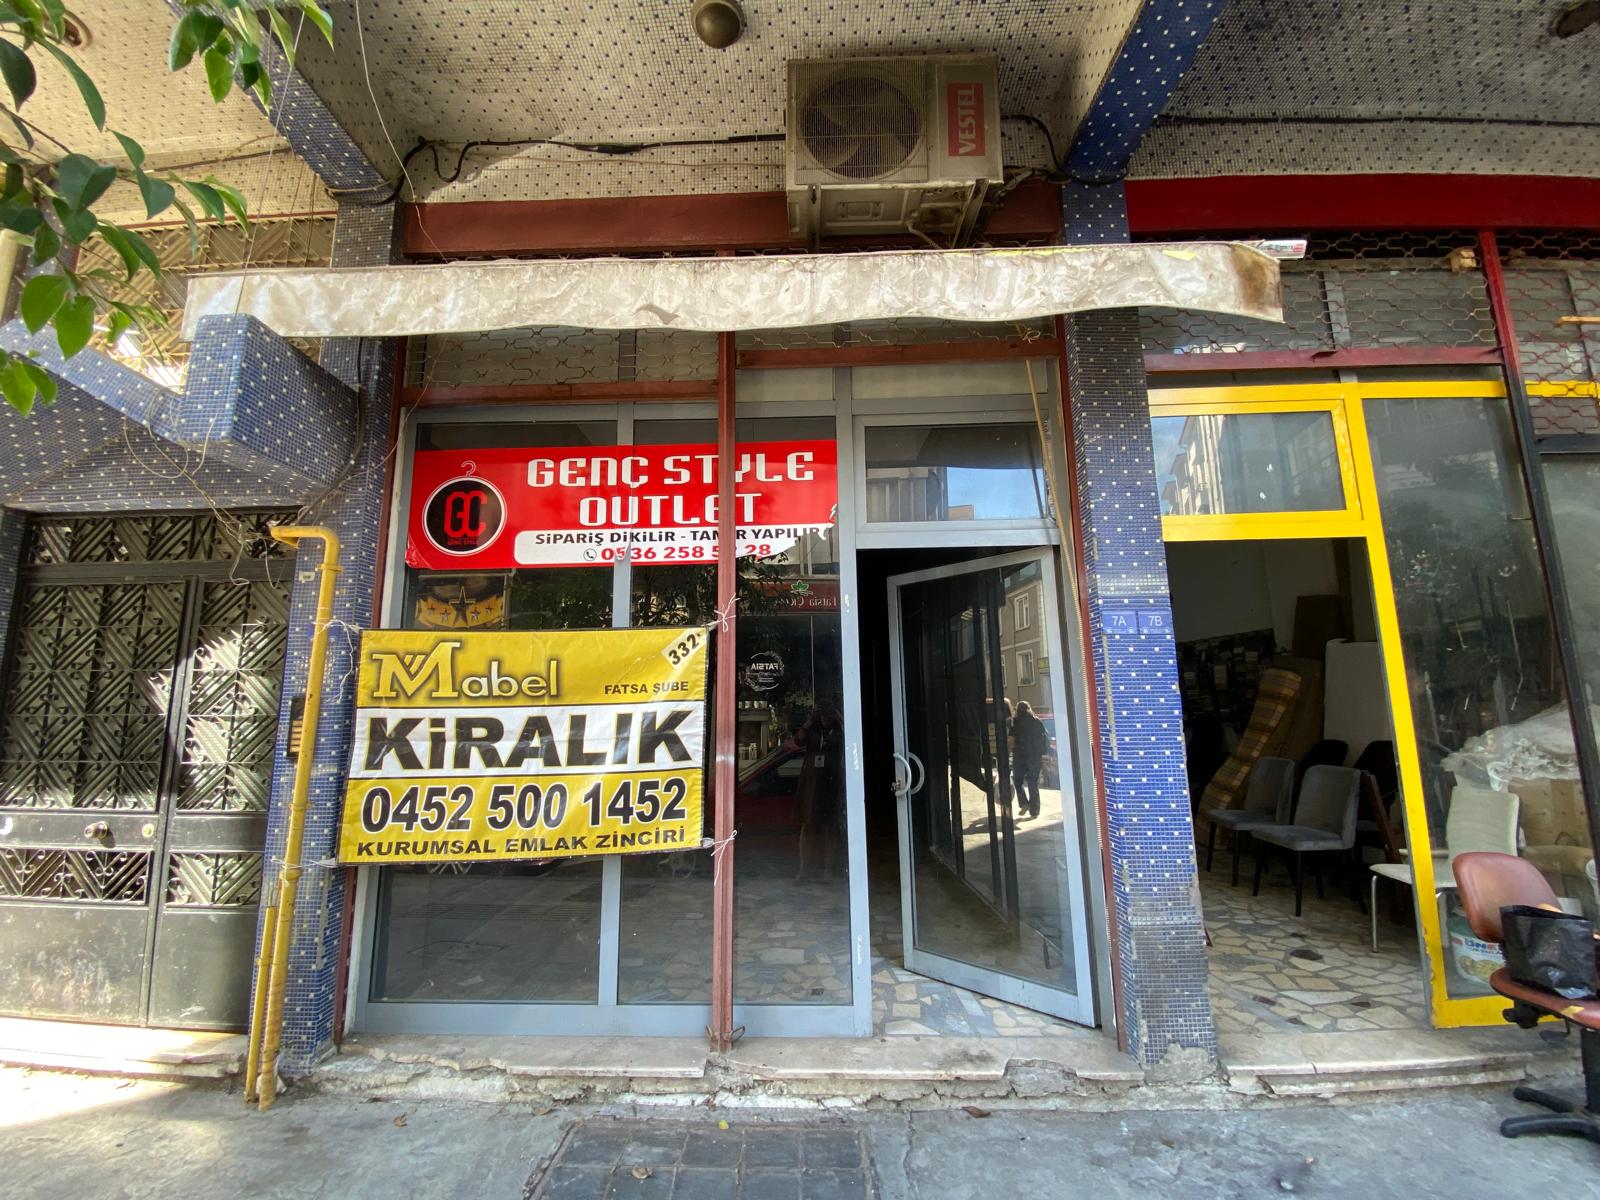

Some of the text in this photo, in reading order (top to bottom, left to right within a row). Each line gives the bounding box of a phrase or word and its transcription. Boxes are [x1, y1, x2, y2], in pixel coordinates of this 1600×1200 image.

[957, 86, 977, 155] VESTEL
[527, 456, 649, 489] GENÇ
[663, 546, 705, 560] 258
[1112, 615, 1127, 627] 7A
[1148, 615, 1163, 627] 7B
[372, 641, 558, 698] Mabel
[604, 681, 689, 695] FATSA ŞUBE
[361, 776, 688, 834] 0452 500 1452
[356, 839, 497, 857] KURUMSAL
[505, 836, 588, 852] EMLAK
